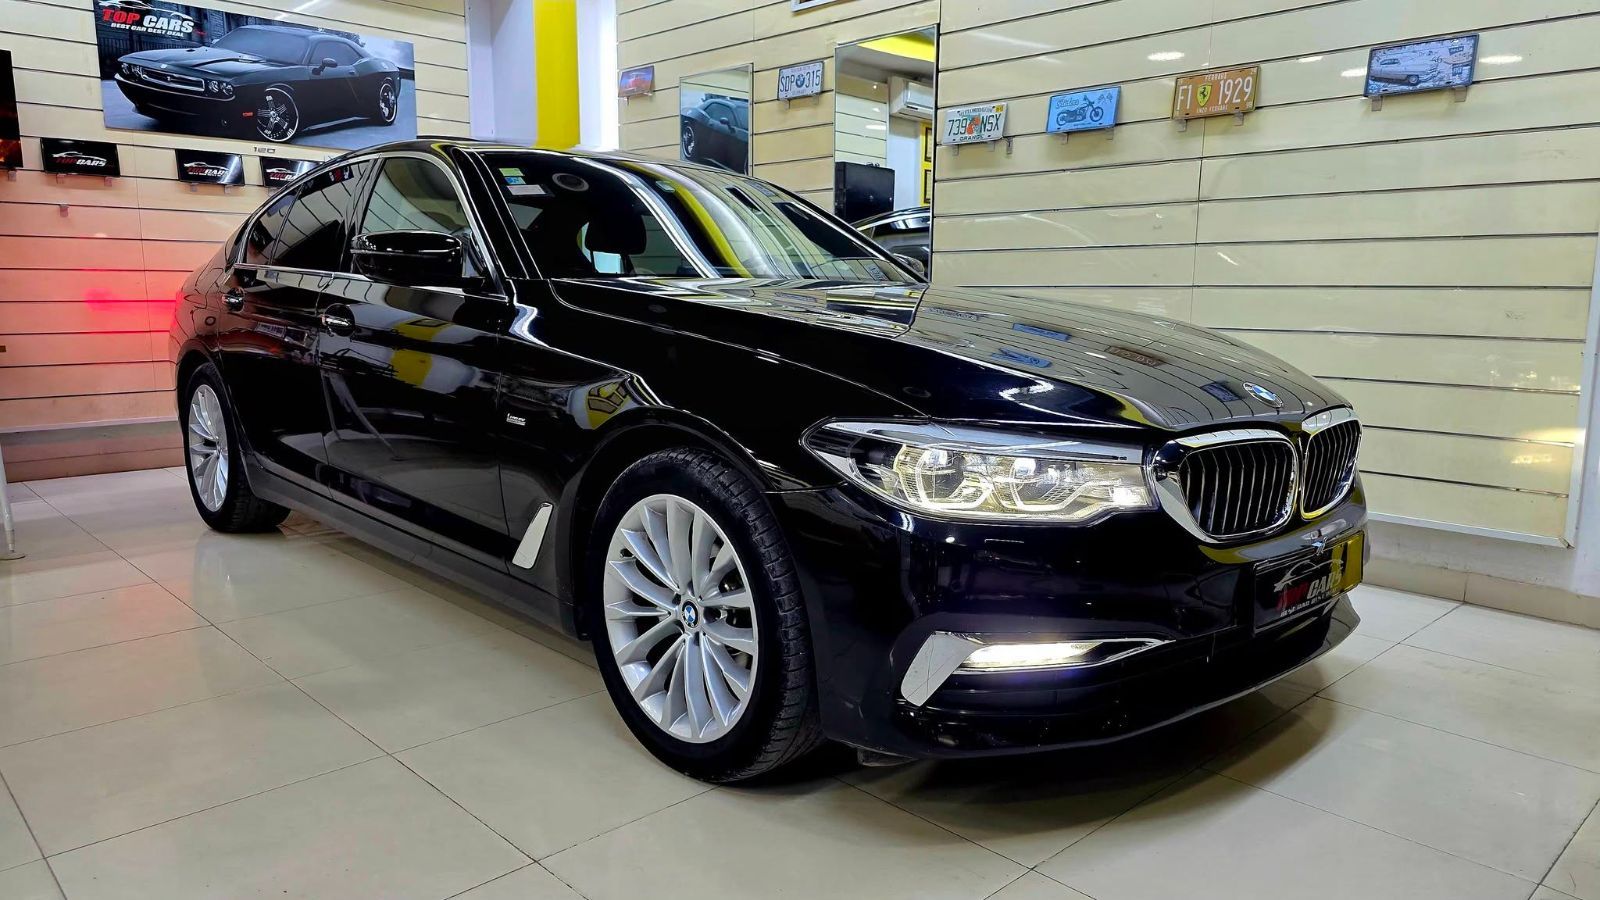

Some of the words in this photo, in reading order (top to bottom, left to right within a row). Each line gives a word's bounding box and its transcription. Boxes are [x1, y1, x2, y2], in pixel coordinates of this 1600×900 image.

[103, 8, 140, 25] TOP
[142, 15, 195, 33] CARS
[111, 22, 130, 30] BEST
[780, 74, 795, 92] SDP
[805, 69, 820, 88] 315
[1177, 84, 1193, 110] F1
[1218, 76, 1253, 105] 1929
[948, 117, 968, 136] 739
[980, 113, 1002, 133] NSX
